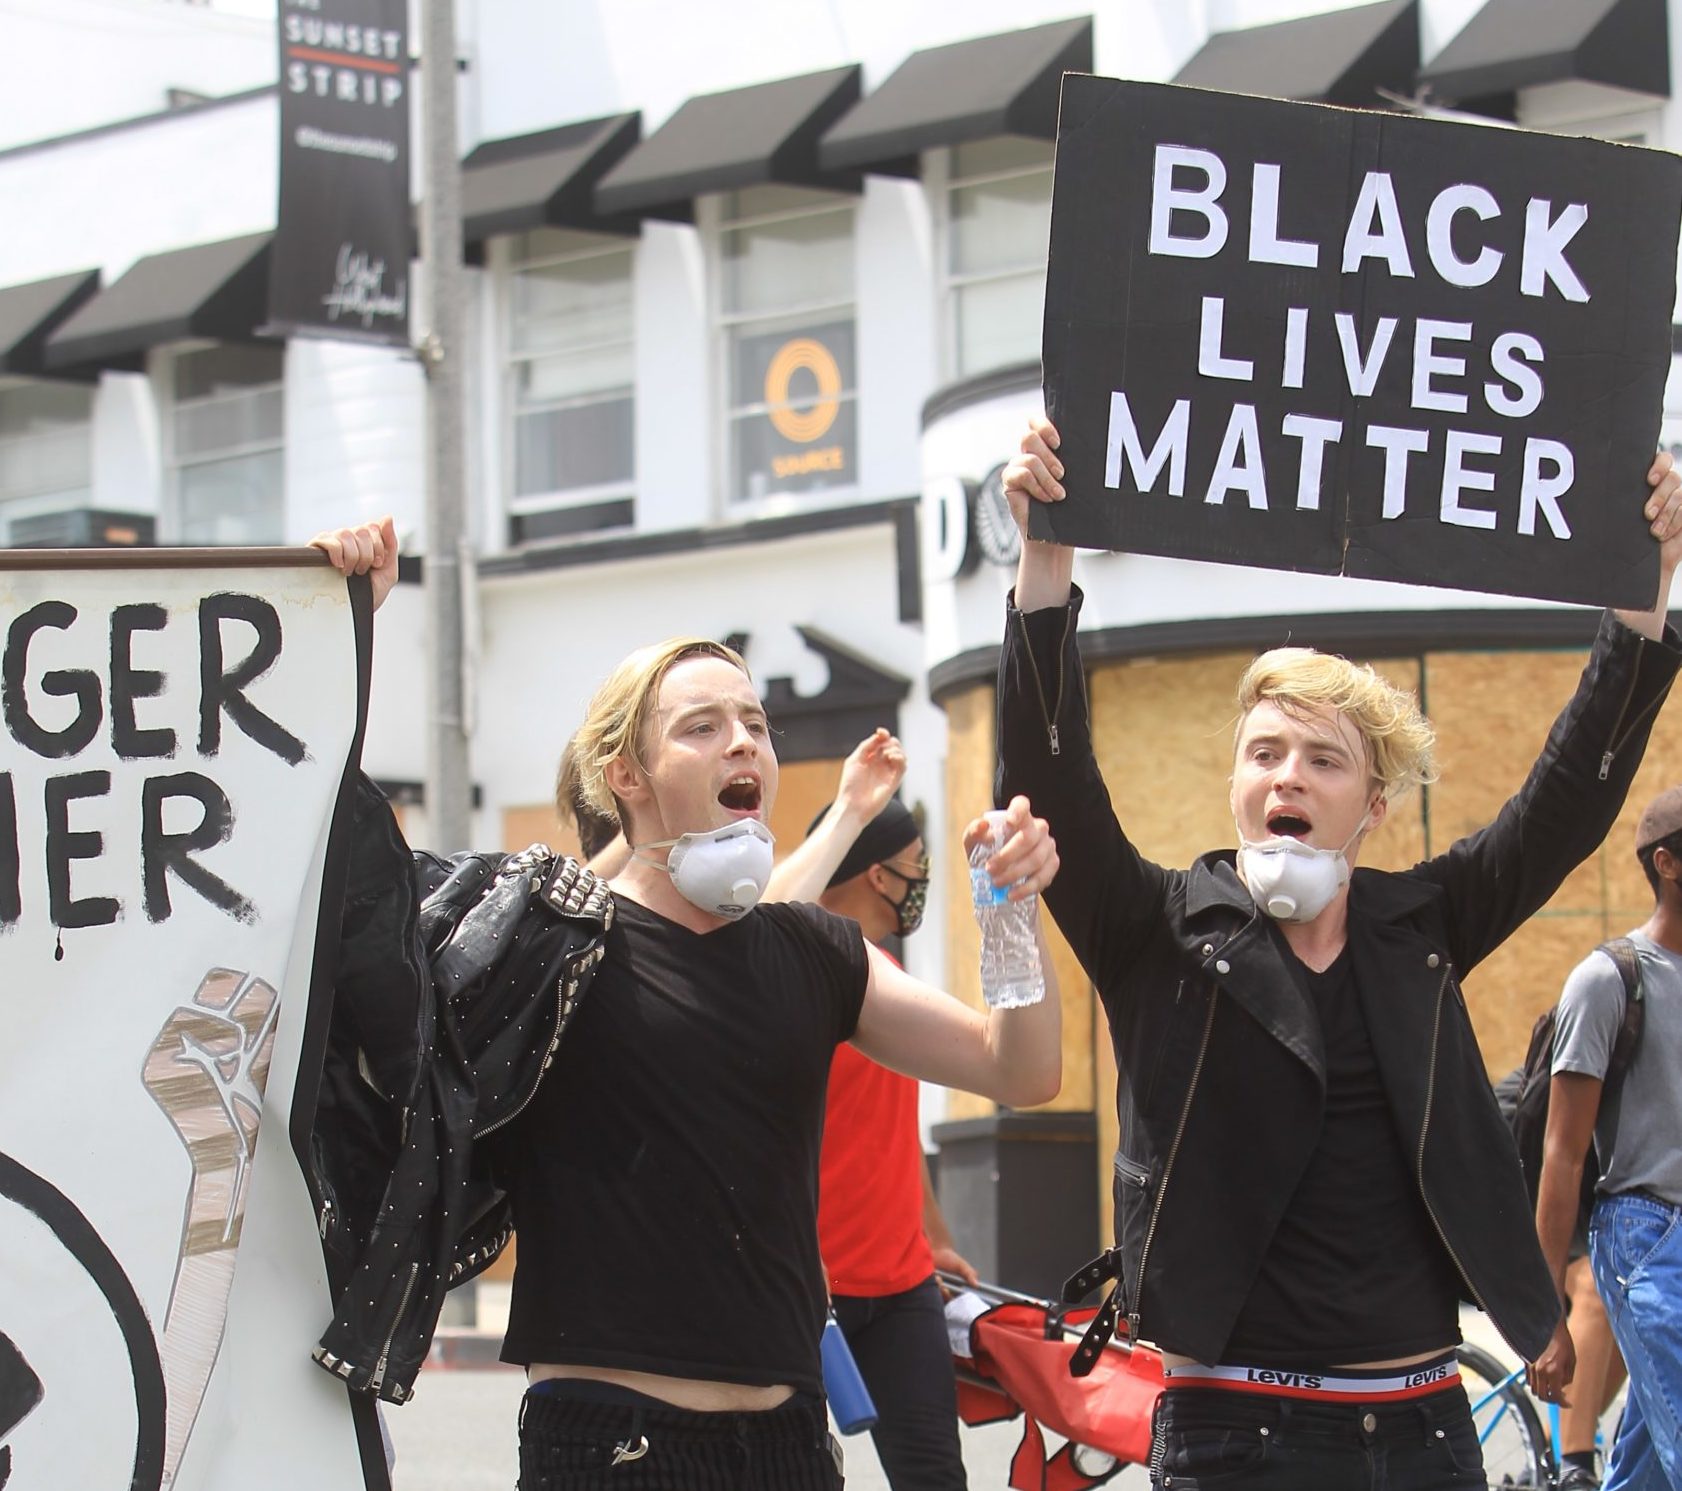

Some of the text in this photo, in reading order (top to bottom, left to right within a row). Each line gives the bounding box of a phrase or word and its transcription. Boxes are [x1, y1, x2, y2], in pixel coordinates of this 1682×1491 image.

[285, 14, 401, 59] SUNSET
[287, 61, 402, 107] STRIP
[1148, 143, 1591, 304] BLACK
[1197, 296, 1544, 418] LIVES
[1103, 391, 1575, 541] MATTER
[0, 770, 260, 934] ER
